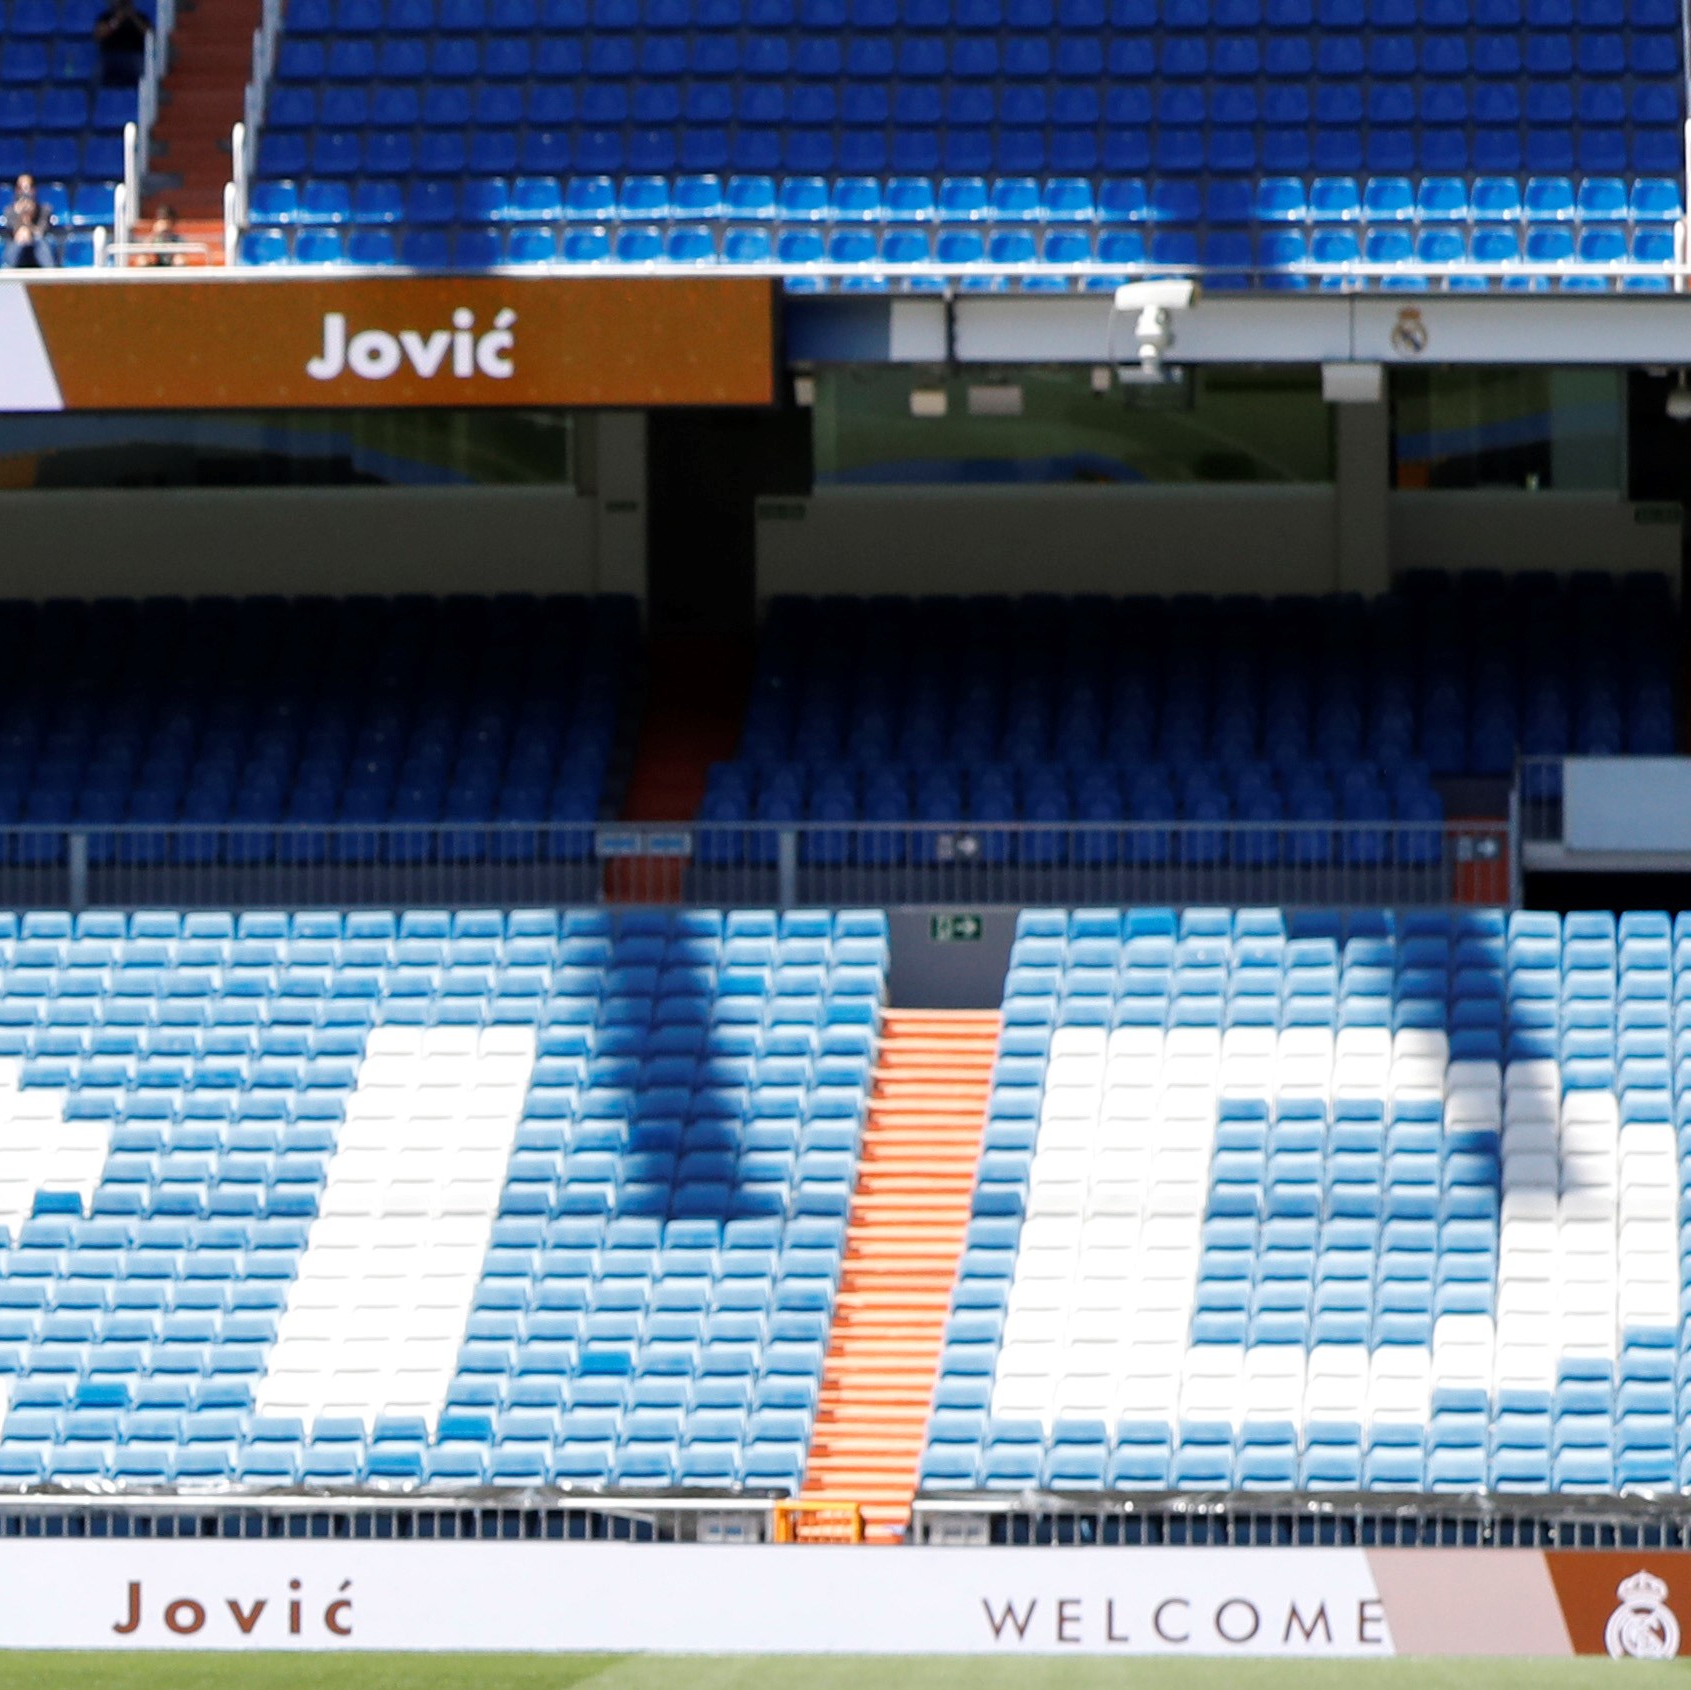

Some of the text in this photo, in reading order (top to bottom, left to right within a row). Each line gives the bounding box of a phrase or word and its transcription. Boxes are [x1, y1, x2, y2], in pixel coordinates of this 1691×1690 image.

[305, 305, 518, 380] Jović
[111, 1577, 354, 1637] Jović
[980, 1597, 1386, 1644] WELCOME
